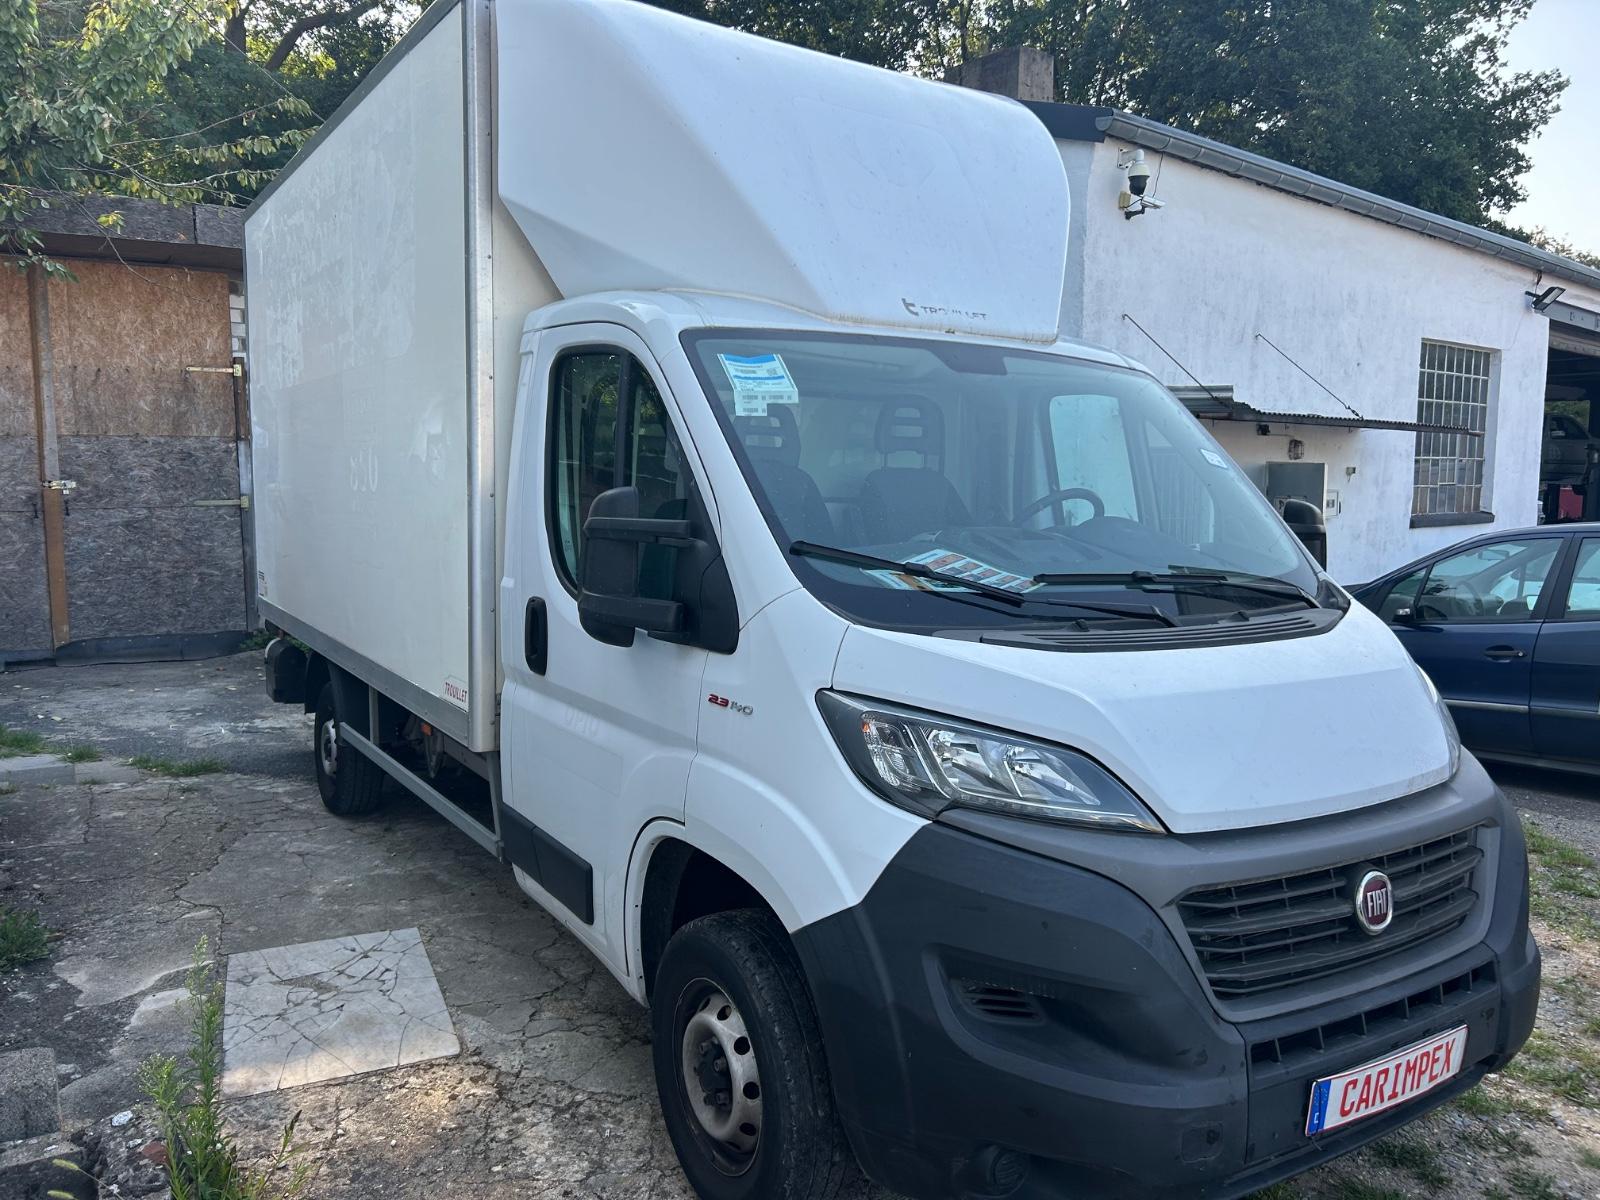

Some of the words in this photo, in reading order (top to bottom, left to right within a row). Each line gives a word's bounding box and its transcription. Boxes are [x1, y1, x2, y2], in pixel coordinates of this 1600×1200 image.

[444, 681, 468, 703] TROUILLET
[1367, 888, 1387, 918] FIAT
[1339, 1038, 1457, 1118] CARIMPEX
